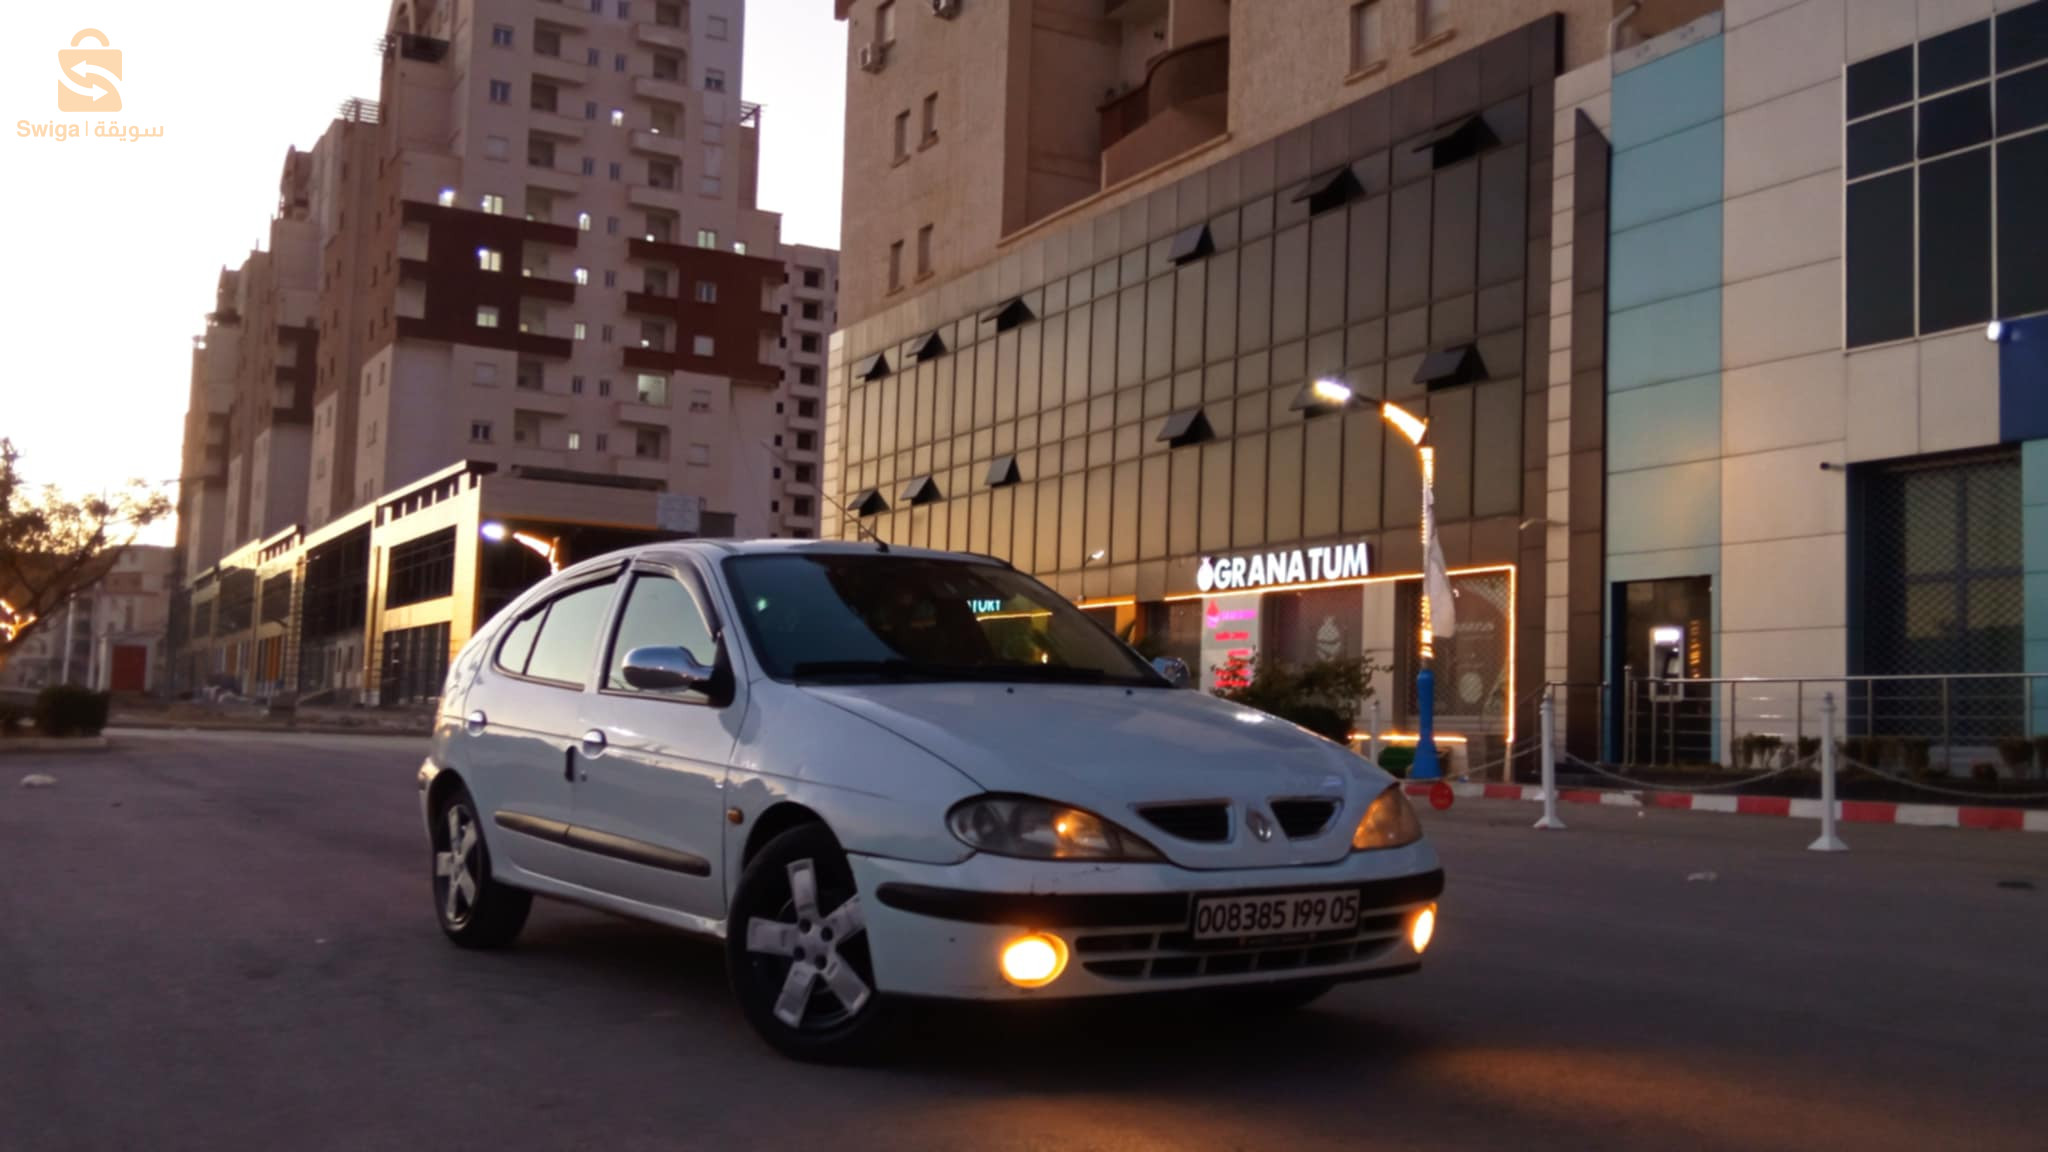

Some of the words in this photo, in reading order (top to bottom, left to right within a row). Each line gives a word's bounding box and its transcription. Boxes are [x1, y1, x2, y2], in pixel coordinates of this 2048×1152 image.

[1213, 542, 1369, 590] GRANATUM
[1197, 903, 1286, 933] 008385
[1291, 899, 1327, 928] 199
[1329, 896, 1357, 923] 05
